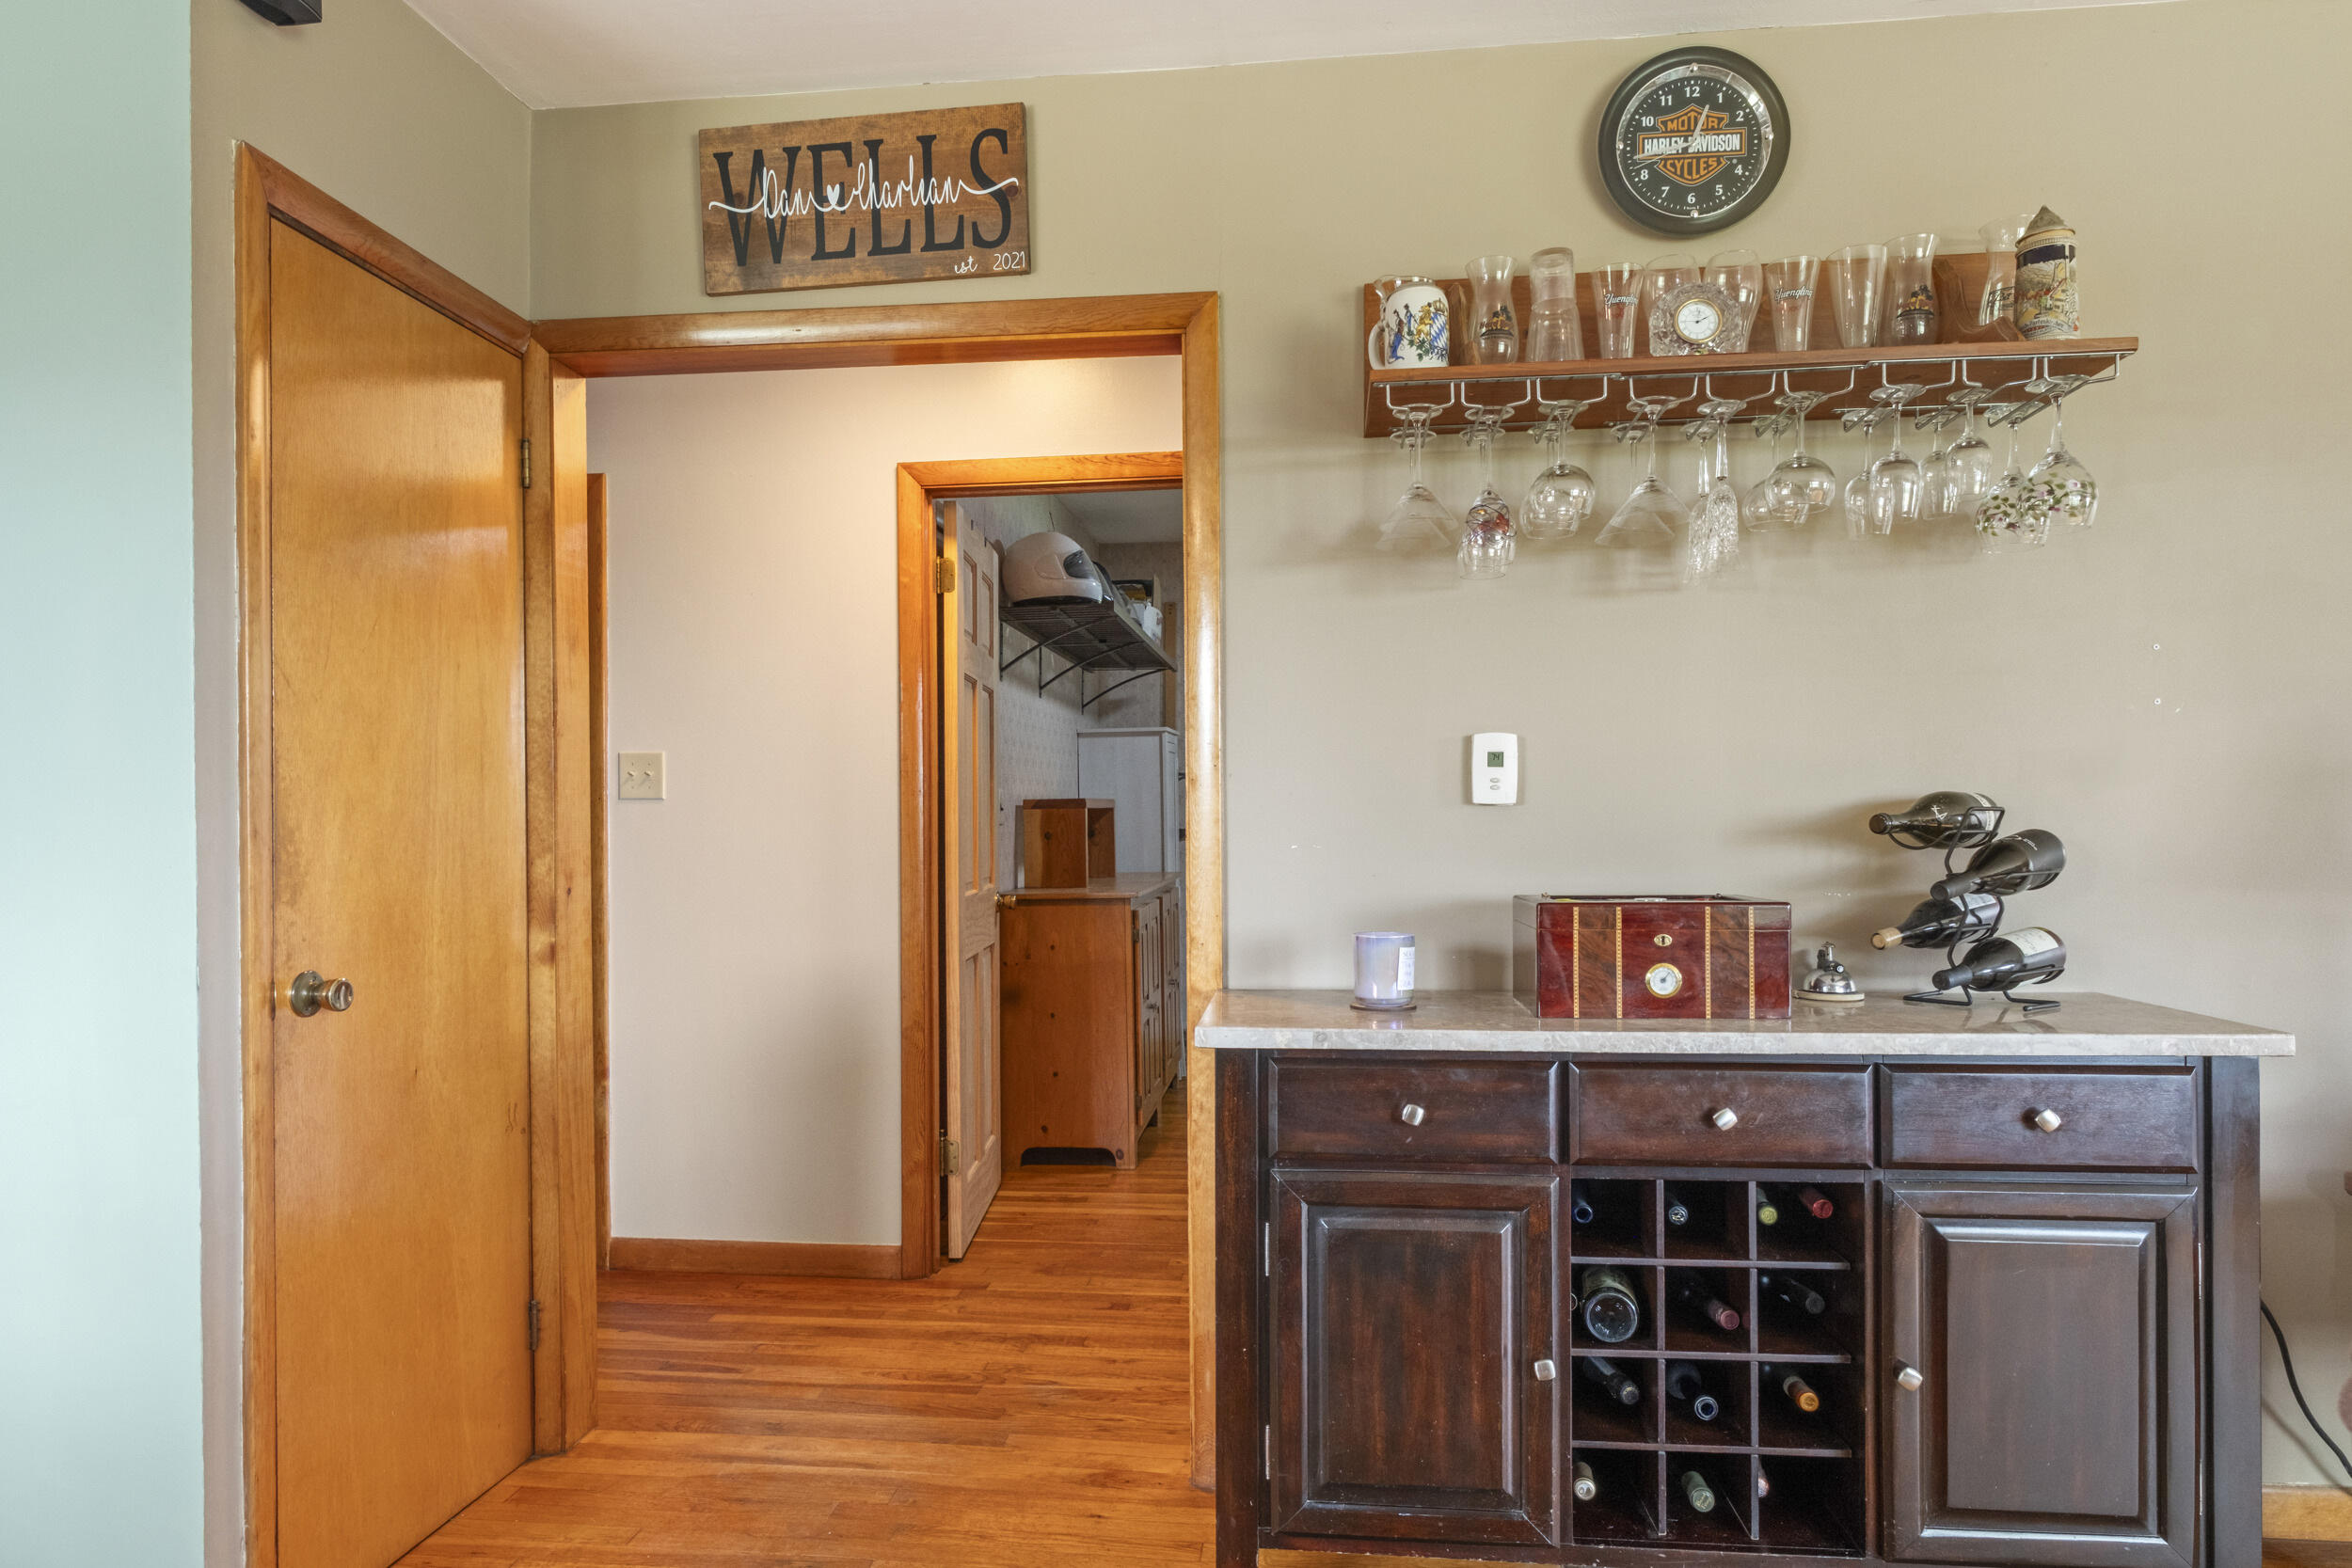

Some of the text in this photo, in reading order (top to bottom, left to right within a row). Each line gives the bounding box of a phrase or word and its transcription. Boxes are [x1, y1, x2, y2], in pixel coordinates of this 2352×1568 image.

[1684, 87, 1701, 98] 12
[1716, 92, 1724, 103] 1
[1659, 95, 1673, 106] 11
[1640, 116, 1655, 127] 10
[1667, 112, 1718, 131] MOTOR
[1735, 110, 1744, 121] 2
[1666, 157, 1718, 180] CYCLES
[1734, 164, 1743, 176] 4
[1640, 169, 1648, 181] 8
[1661, 186, 1670, 198] 7
[1715, 184, 1724, 196] 5
[712, 127, 1012, 267] WELLS
[1687, 192, 1696, 204] 6
[954, 250, 1025, 274] est 2021
